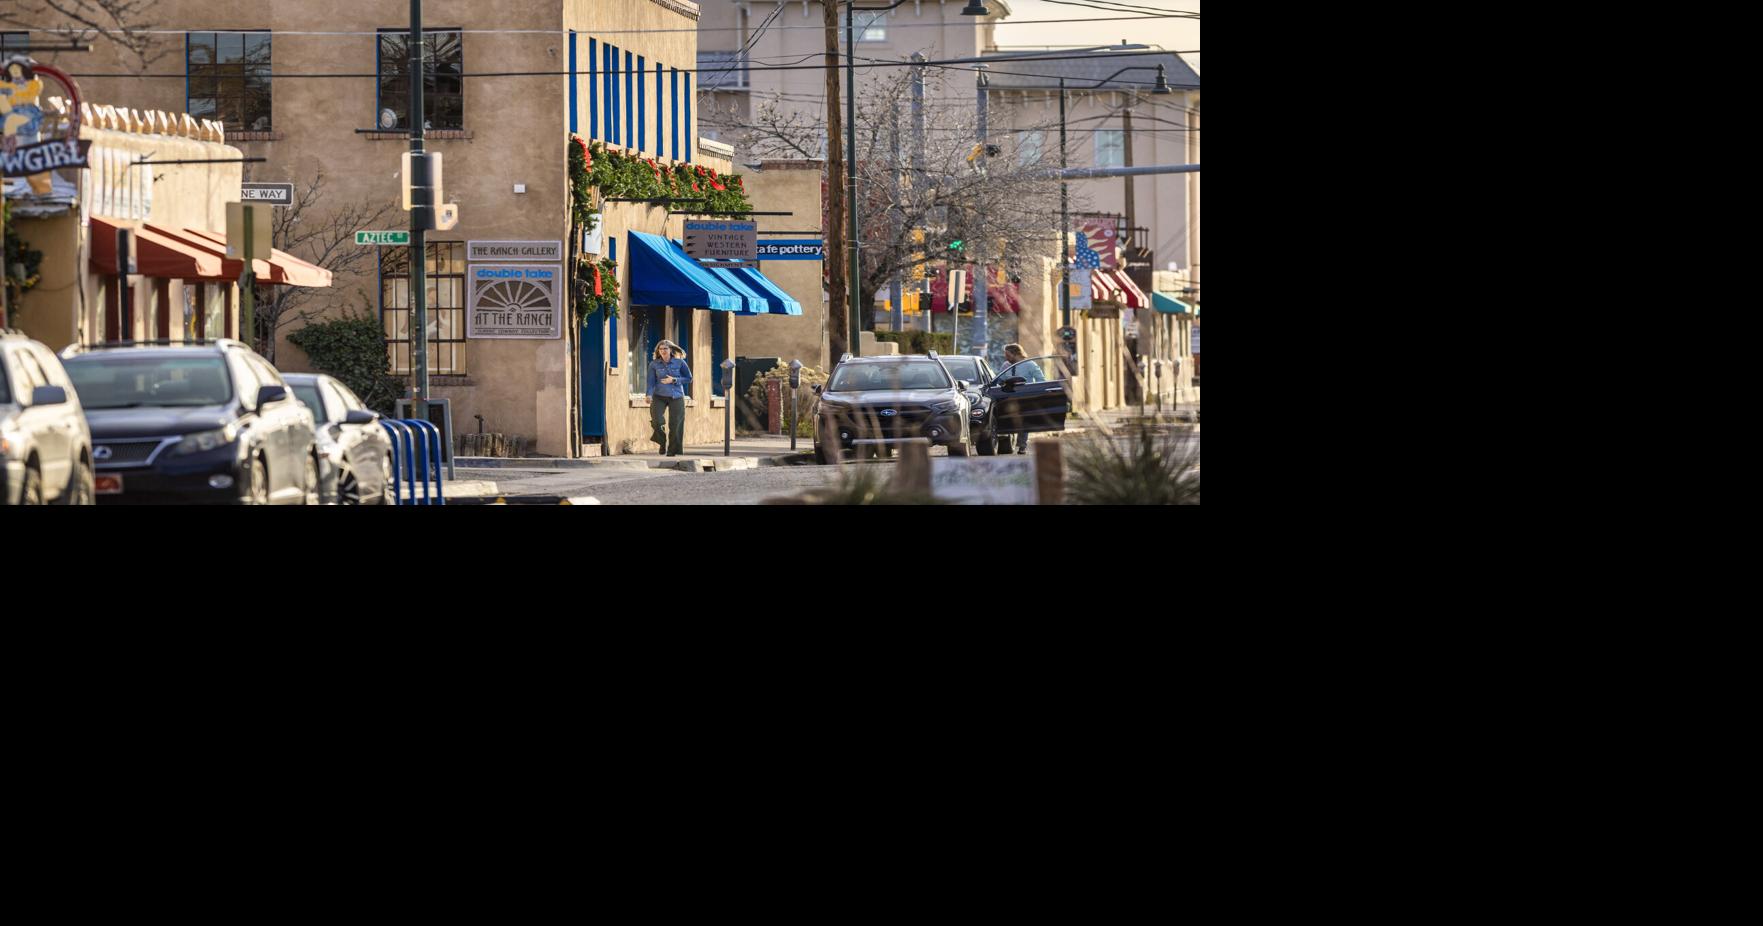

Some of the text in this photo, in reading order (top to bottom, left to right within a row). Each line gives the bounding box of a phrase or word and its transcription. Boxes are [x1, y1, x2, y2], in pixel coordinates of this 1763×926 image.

[0, 140, 86, 173] WGIRL
[259, 189, 283, 199] WAY
[685, 221, 754, 231] double take
[362, 232, 394, 243] AZTEC
[472, 246, 557, 256] THE RANCH GALLERY
[767, 244, 778, 254] fe
[779, 244, 823, 255] pottery
[476, 268, 553, 279] double take
[474, 312, 552, 326] AT THE RANCH
